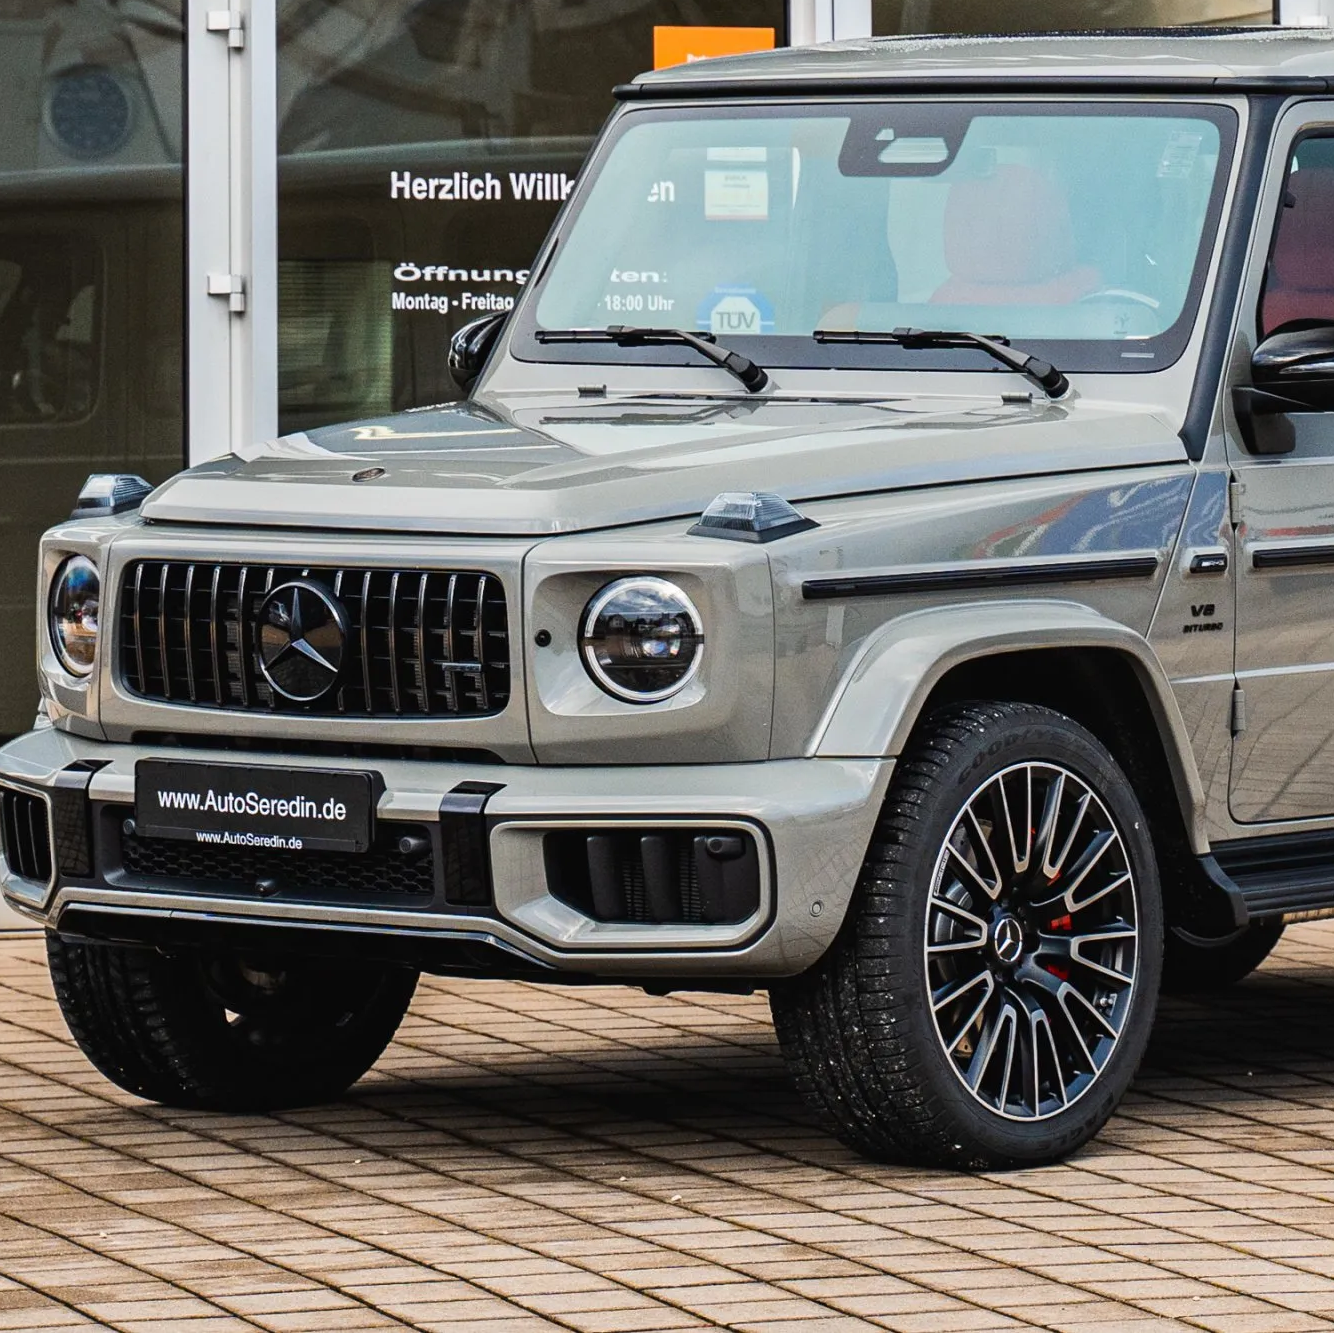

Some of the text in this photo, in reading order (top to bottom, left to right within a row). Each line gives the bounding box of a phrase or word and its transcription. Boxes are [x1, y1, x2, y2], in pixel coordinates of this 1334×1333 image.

[390, 171, 676, 203] Herzlich Willken
[391, 292, 449, 314] Montag
[604, 294, 644, 311] 18:00
[647, 294, 675, 311] Uhr
[716, 310, 756, 330] TÜV
[157, 789, 347, 821] www.AutoSeredin.de
[195, 831, 303, 850] www.AutoSeredin.de
